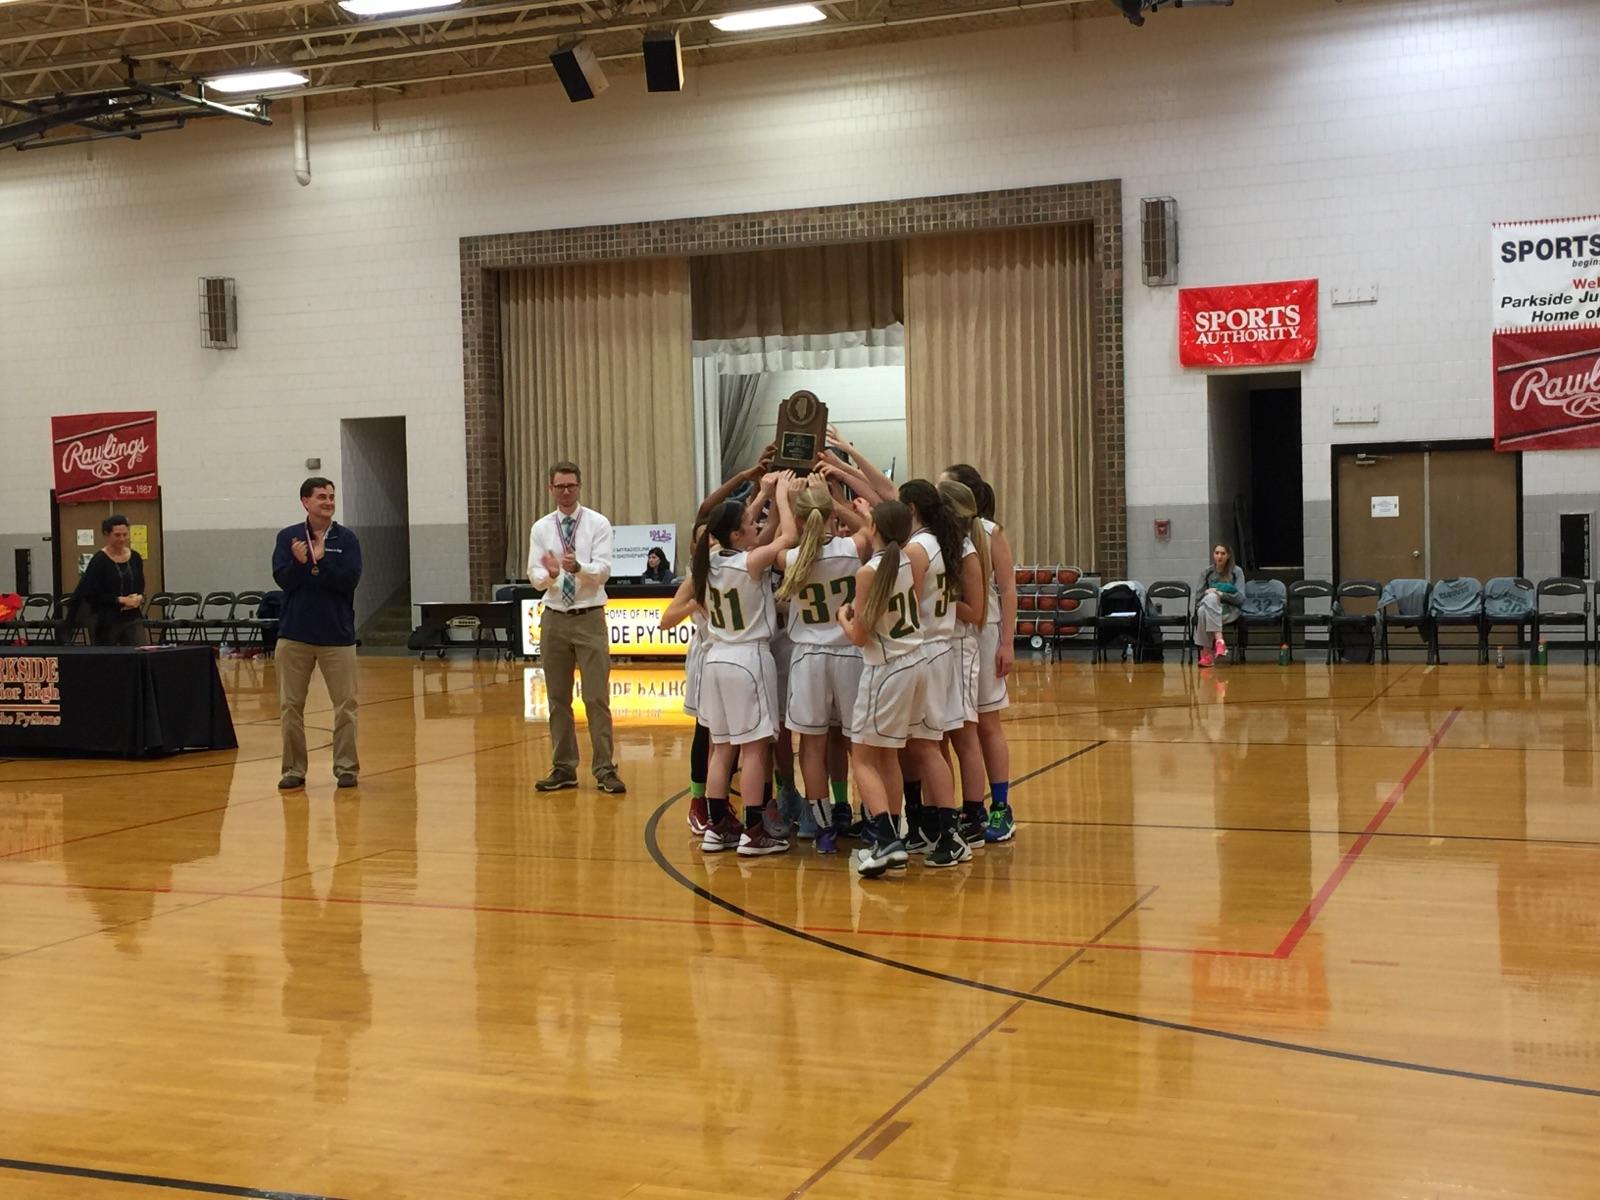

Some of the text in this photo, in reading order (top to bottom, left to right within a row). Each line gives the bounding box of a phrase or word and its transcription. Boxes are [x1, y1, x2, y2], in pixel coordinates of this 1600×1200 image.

[1501, 233, 1600, 263] SPORTS
[1572, 258, 1600, 268] begin
[1501, 293, 1573, 308] Parkside
[1195, 305, 1300, 332] SPORTS
[1531, 310, 1579, 322] Home
[1195, 326, 1300, 344] AUTHORITY
[62, 433, 149, 473] Rawlings
[643, 609, 660, 619] THE
[24, 683, 60, 704] High
